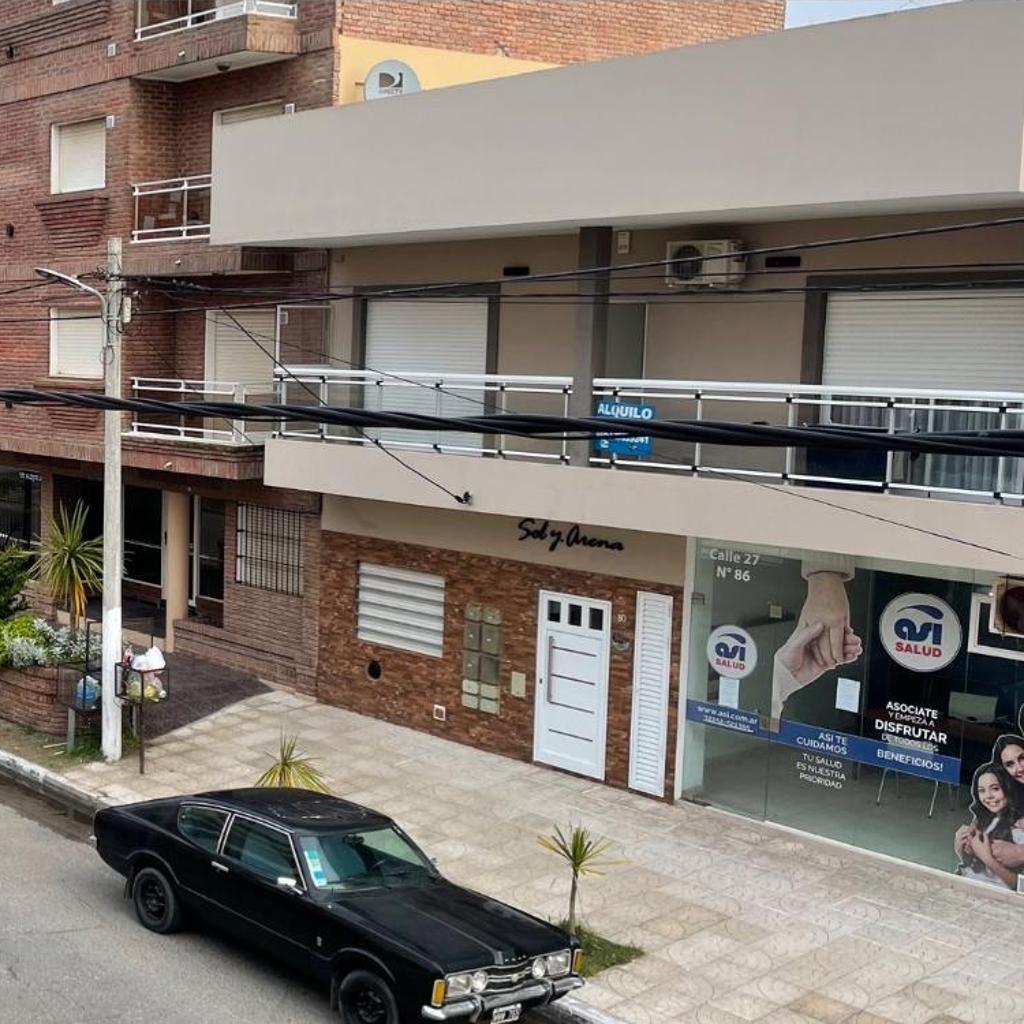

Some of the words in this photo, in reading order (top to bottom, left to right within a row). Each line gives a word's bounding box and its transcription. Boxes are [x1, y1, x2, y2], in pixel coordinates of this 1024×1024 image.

[597, 403, 653, 420] ALQUILO
[517, 518, 550, 541] Sol
[565, 524, 624, 552] Arena
[709, 548, 741, 562] Calle
[743, 553, 760, 566] 27
[734, 569, 751, 582] 86
[895, 642, 942, 658] SALUD
[715, 659, 746, 671] SALUD
[885, 700, 939, 720] ASOCIATE
[895, 712, 927, 726] EMPEZA
[836, 735, 848, 745] TE
[875, 719, 948, 745] DISFRUTAR
[796, 737, 848, 756] CUIDAMOS
[802, 752, 814, 763] TU
[814, 756, 843, 770] SALUD
[877, 748, 944, 773] BENEFICIOS!
[796, 761, 807, 772] ES
[807, 764, 846, 781] NUESTRA
[799, 772, 843, 790] PRIORIDAD
